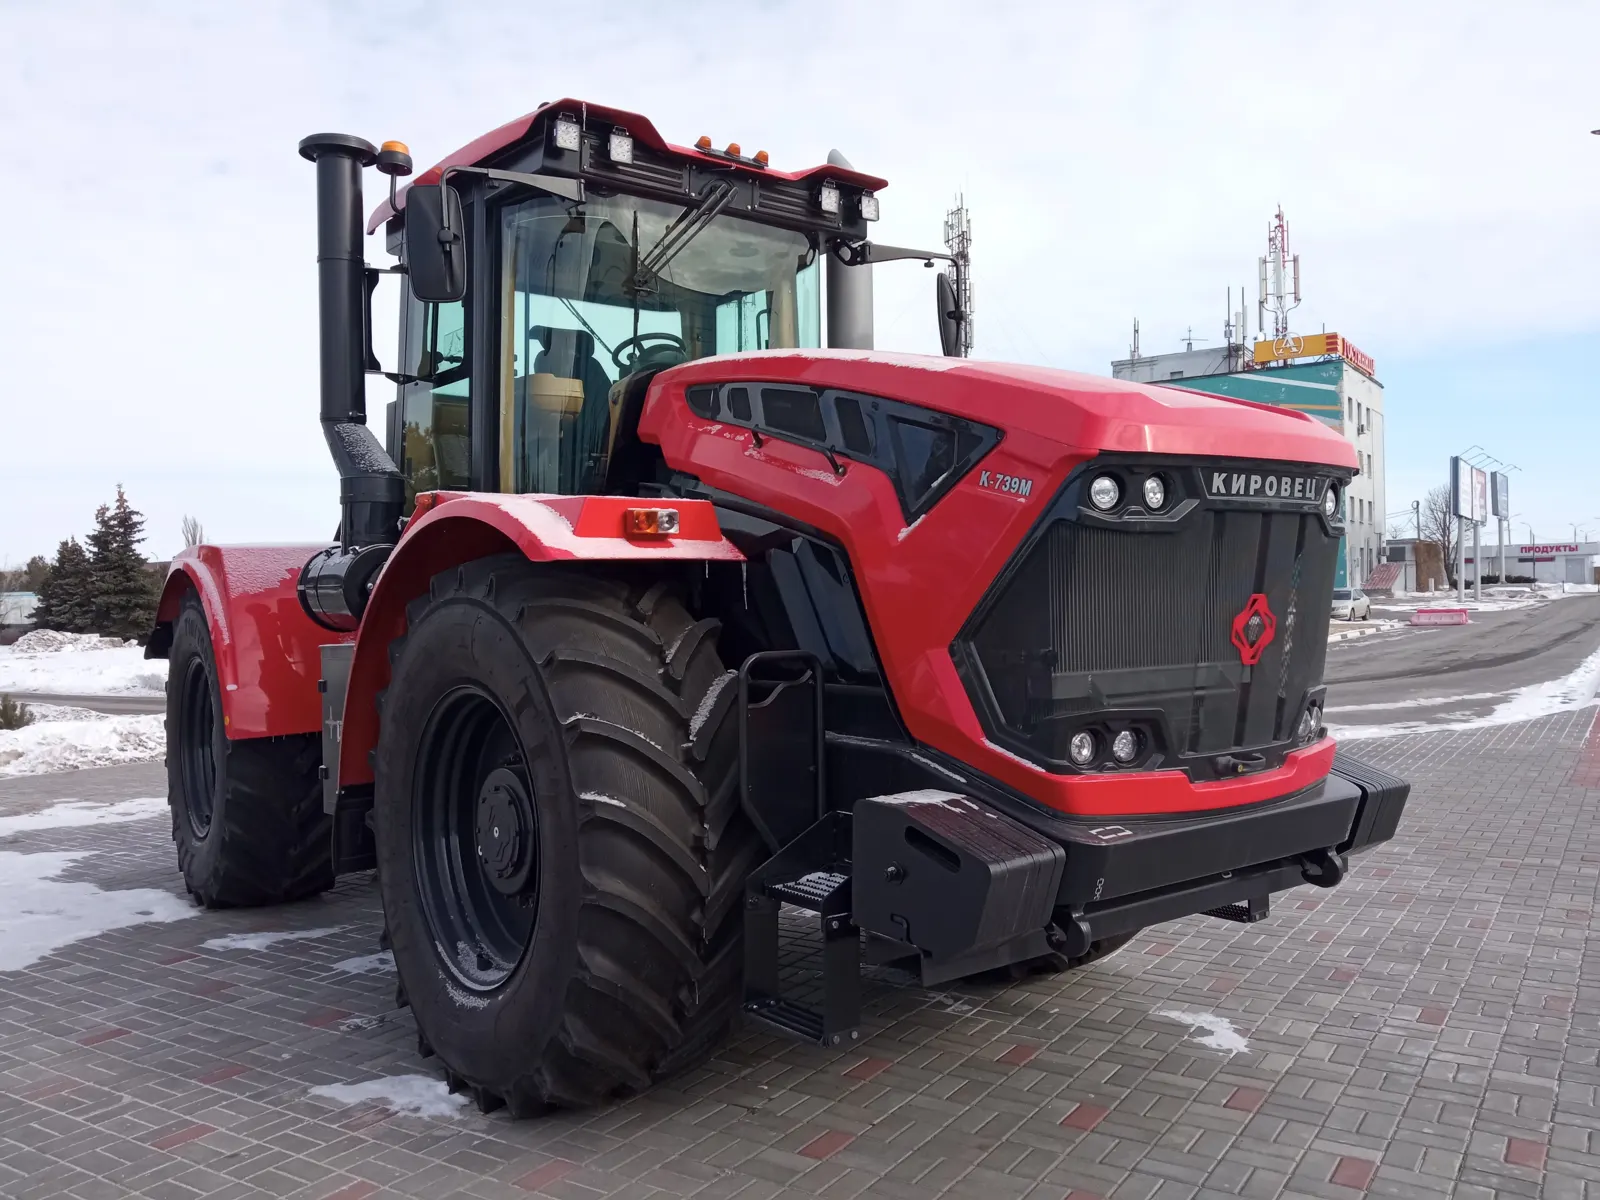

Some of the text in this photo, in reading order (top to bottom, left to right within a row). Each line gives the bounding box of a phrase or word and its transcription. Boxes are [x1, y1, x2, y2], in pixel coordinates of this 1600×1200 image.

[979, 470, 1033, 497] К-739М
[1211, 472, 1317, 500] КИРОВЕЦ
[1520, 544, 1579, 554] ПРОДУКТЫ
